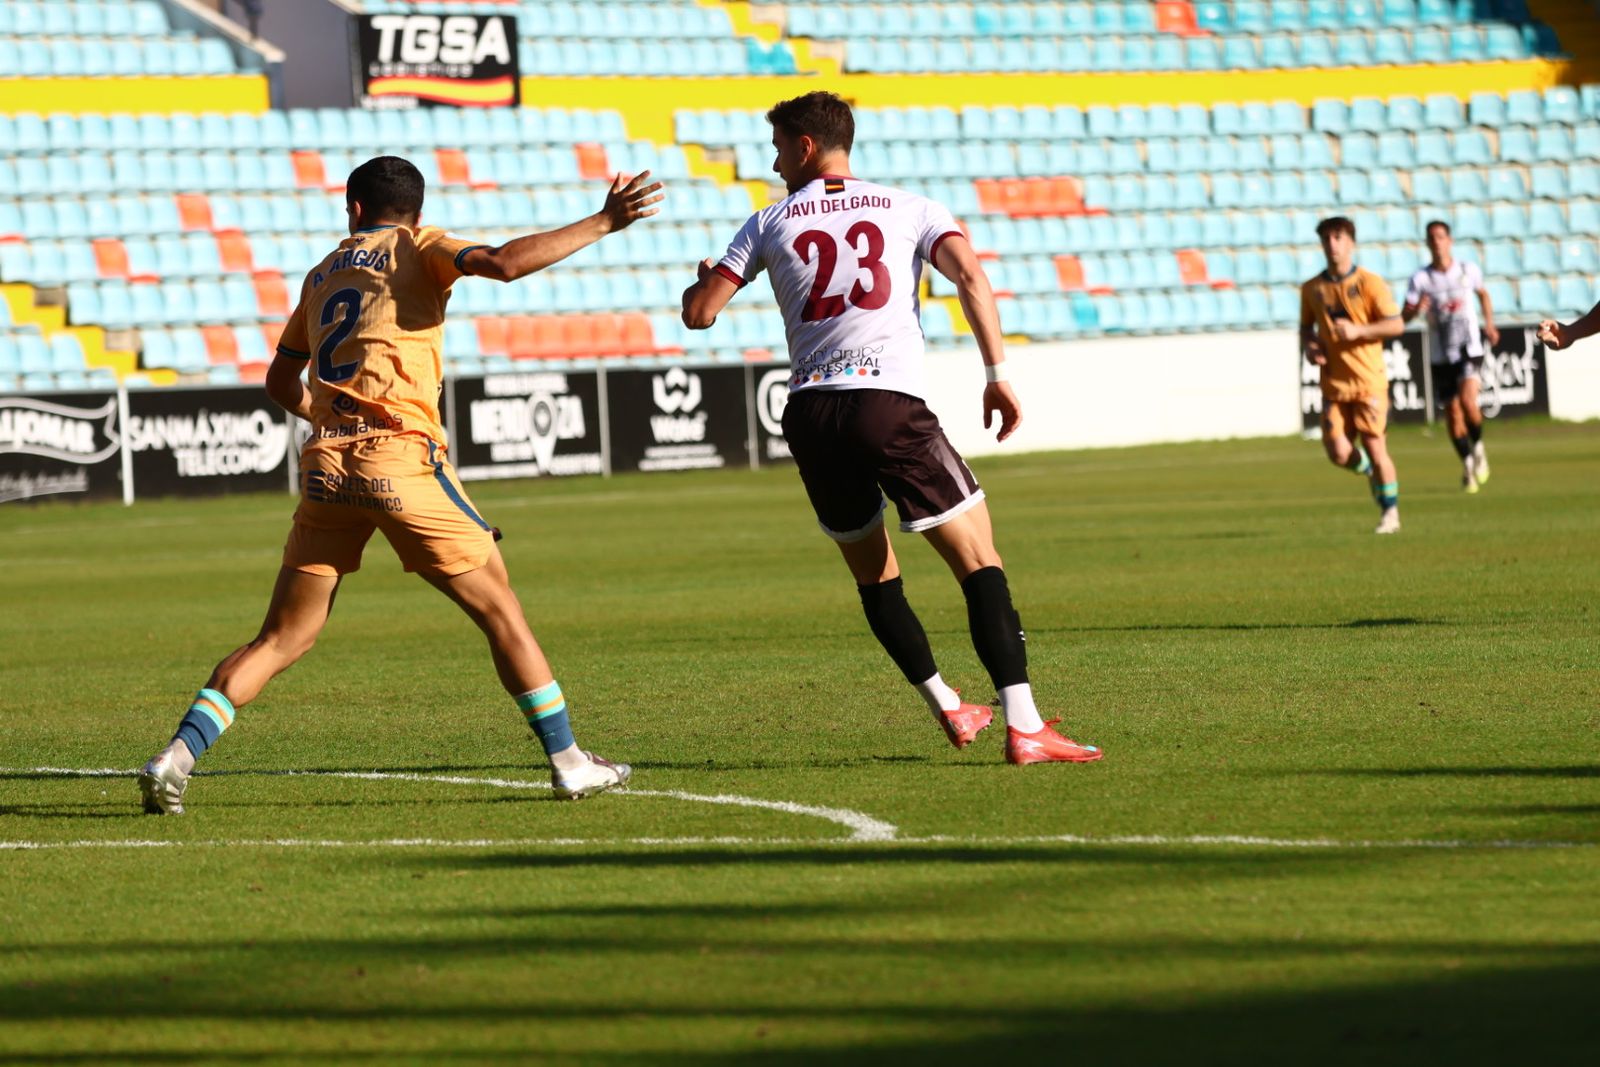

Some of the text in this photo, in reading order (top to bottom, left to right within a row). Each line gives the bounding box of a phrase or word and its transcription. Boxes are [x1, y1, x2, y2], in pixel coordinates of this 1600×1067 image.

[370, 15, 511, 65] TGSA
[784, 195, 891, 220] JAVI DELGADO
[328, 249, 390, 273] ARGOS
[793, 220, 892, 323] 23
[317, 287, 363, 383] 2
[371, 478, 395, 494] DEL
